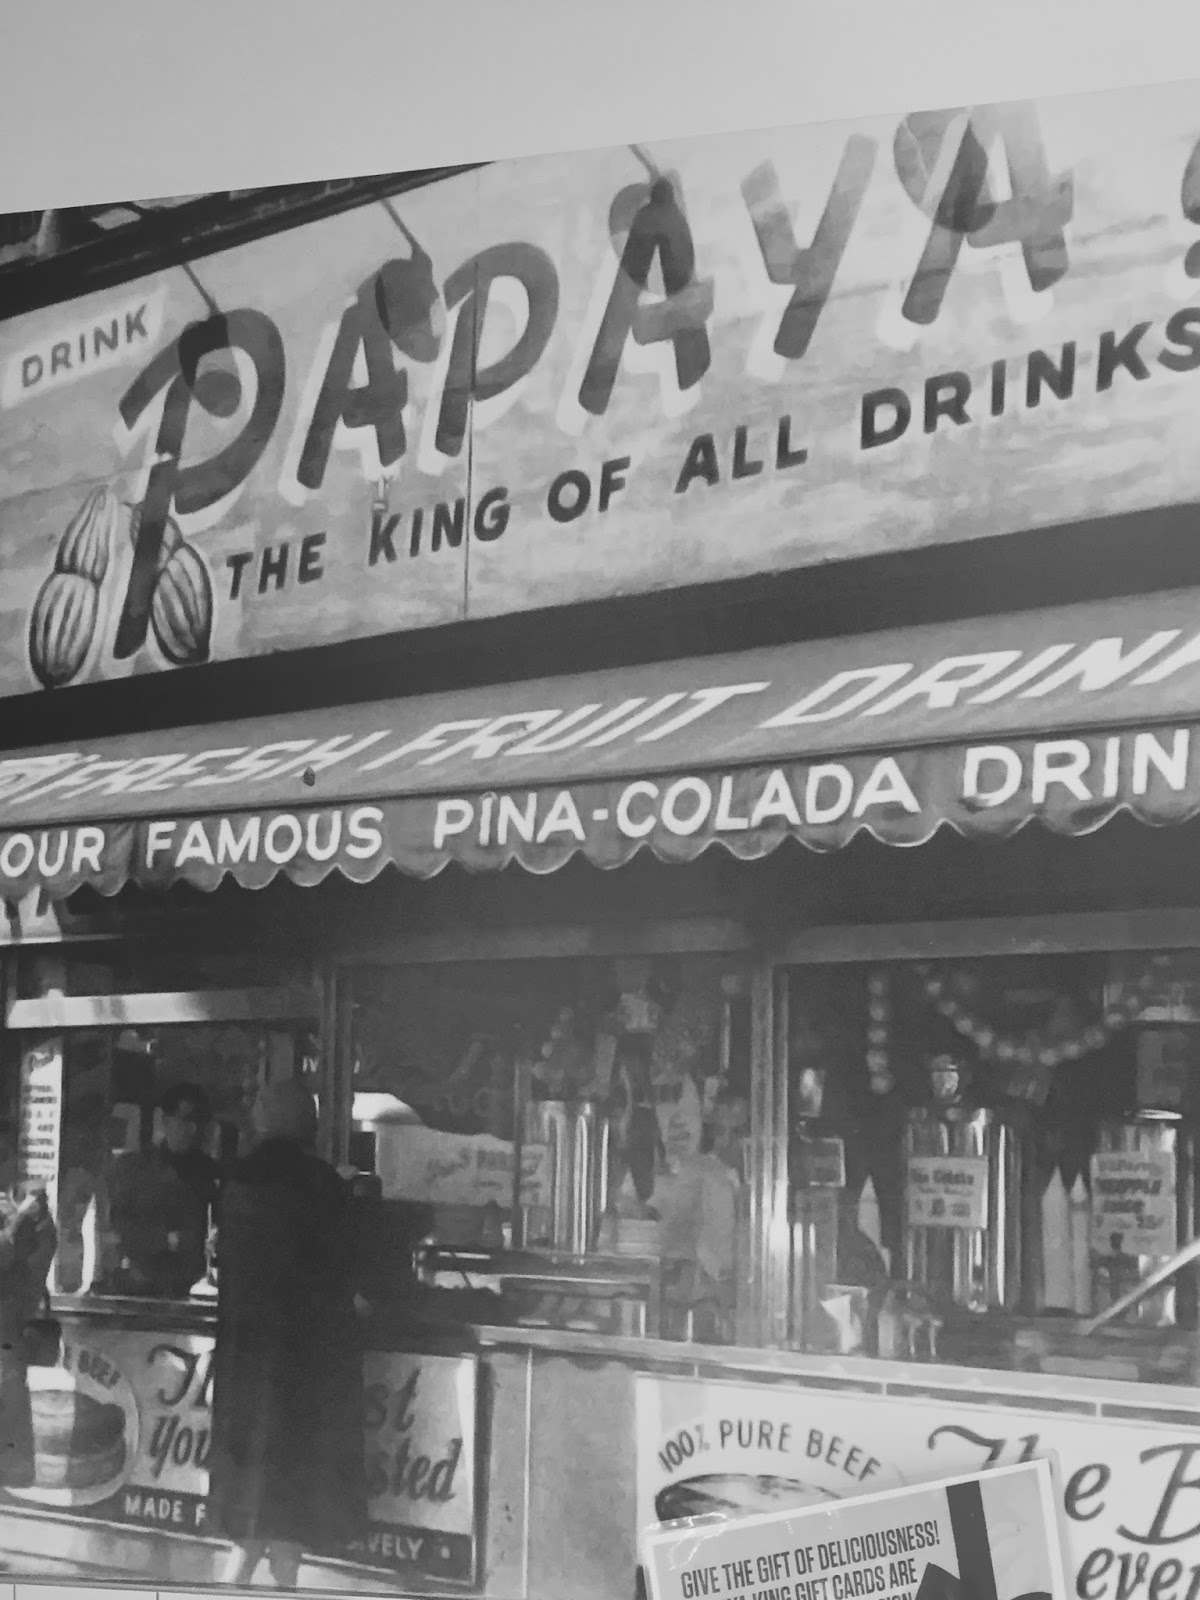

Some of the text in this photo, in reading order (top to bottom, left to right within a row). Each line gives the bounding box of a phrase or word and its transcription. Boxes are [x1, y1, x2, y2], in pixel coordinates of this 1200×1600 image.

[21, 304, 150, 388] DRINK
[226, 307, 1200, 599] THE KING OF ALL DRINKS
[9, 730, 391, 804] FRESH
[357, 681, 771, 771] FRUIT
[0, 729, 1190, 877] OUR FAMOUS PINA-COLADA DRIN
[719, 1418, 792, 1453] PURE
[805, 1428, 881, 1482] BEEF
[125, 1494, 183, 1522] MADE
[681, 1520, 940, 1599] GIVE THE GIFT OF DELICIOUSNESS!
[794, 1578, 828, 1600] GIFT
[832, 1565, 885, 1600] CARDS
[889, 1558, 917, 1589] ARE
